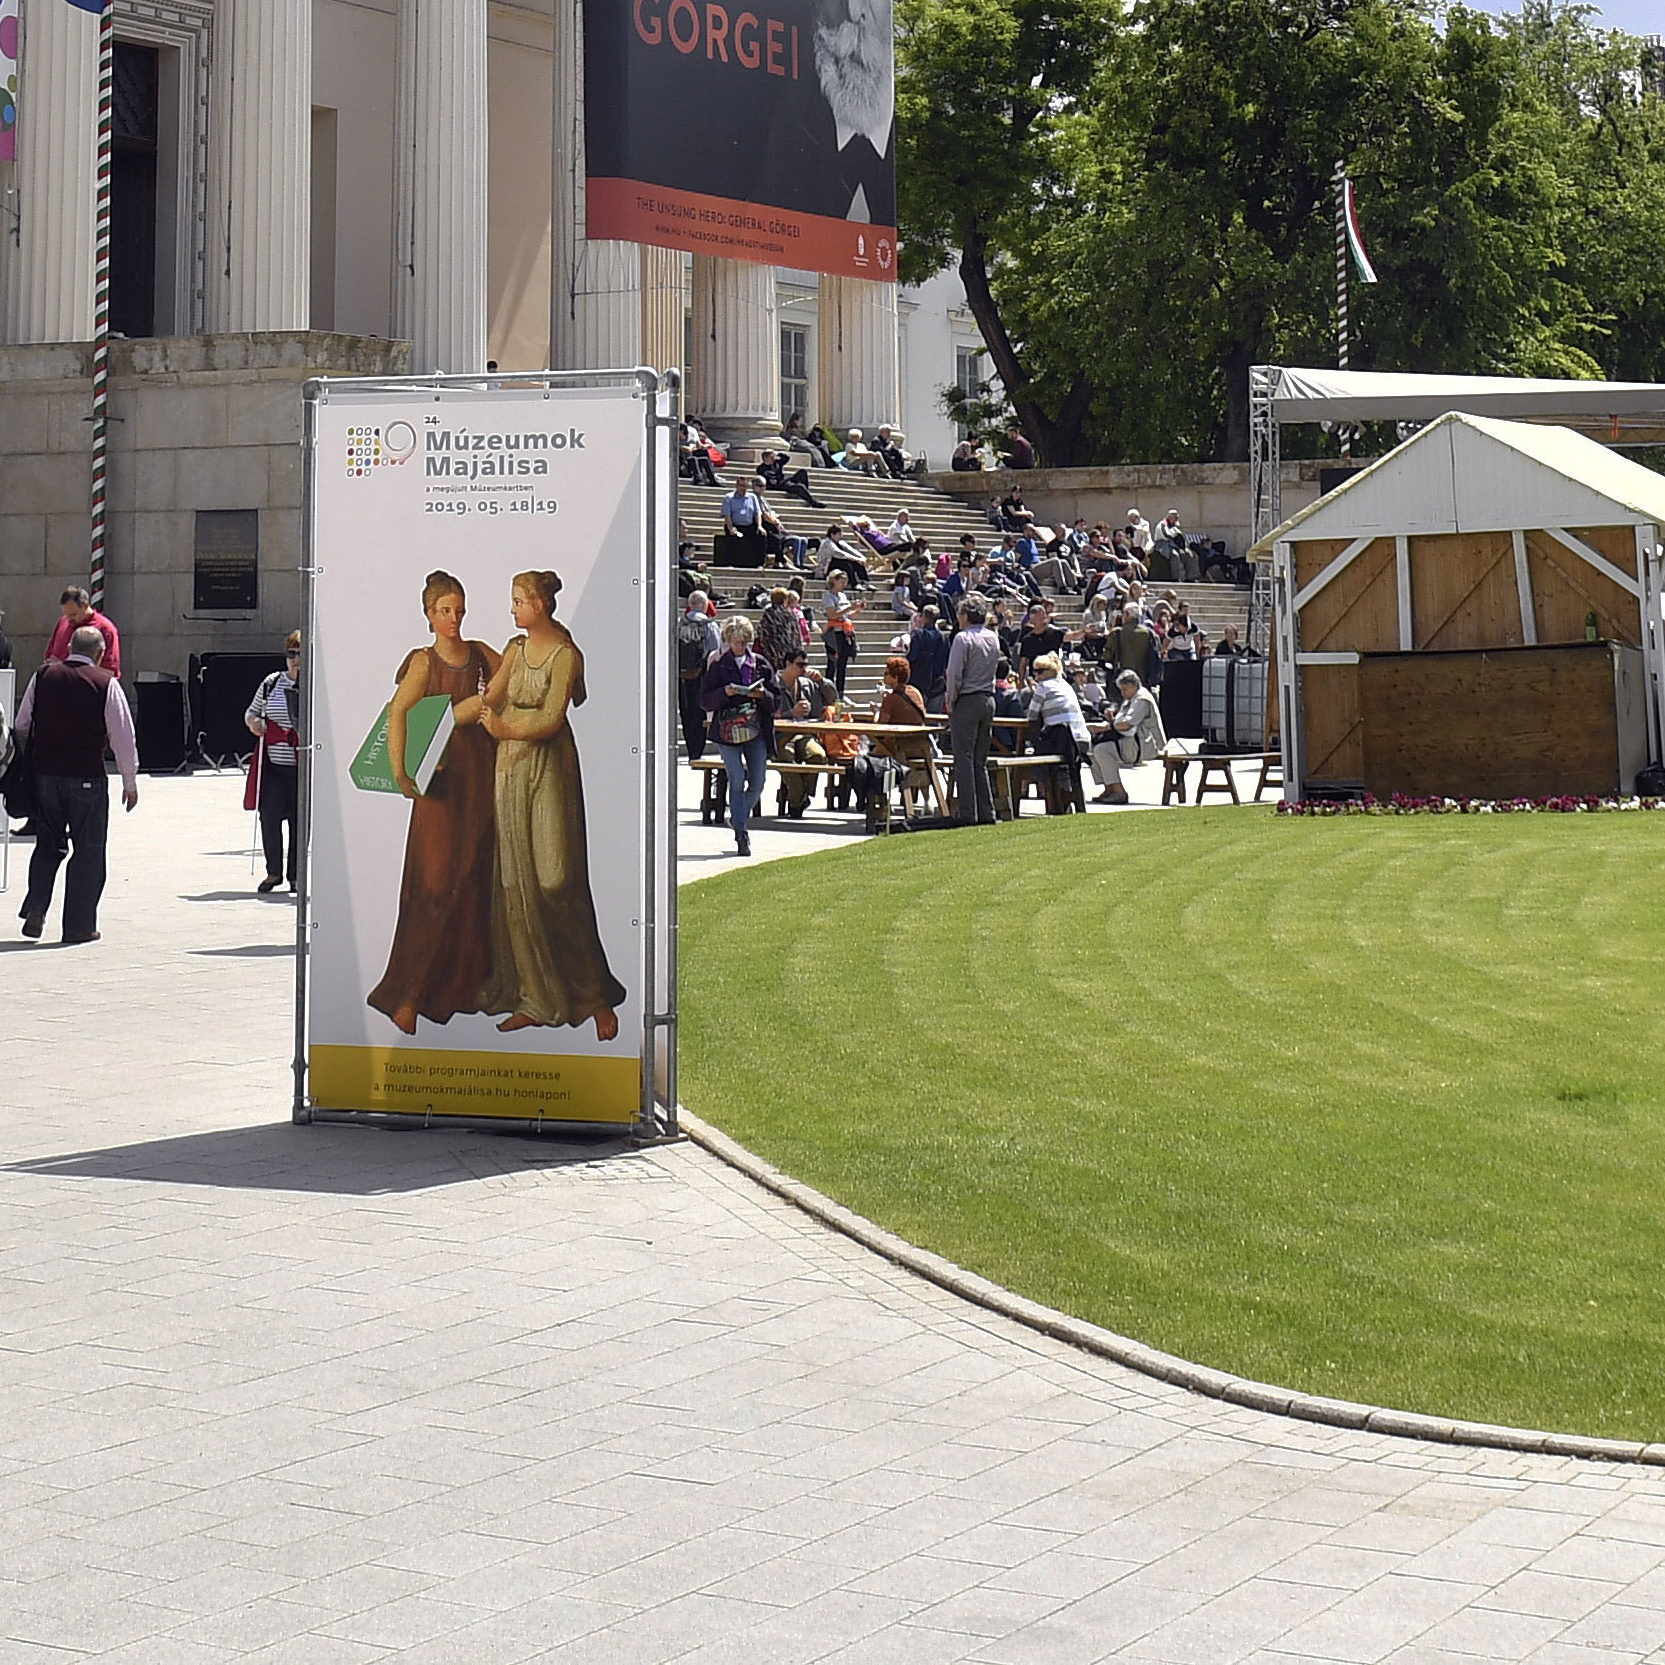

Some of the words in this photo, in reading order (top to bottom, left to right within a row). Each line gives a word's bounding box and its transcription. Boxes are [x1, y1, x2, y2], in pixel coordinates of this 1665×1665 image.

[636, 196, 654, 212] THE
[728, 214, 767, 232] GENERAL
[769, 218, 801, 238] GÖRGEI
[424, 415, 441, 426] 24.
[426, 427, 585, 451] Múzeumok
[426, 452, 548, 481] Majálisa
[425, 500, 472, 515] 2019.
[477, 500, 504, 515] 05.
[383, 1063, 425, 1075] További
[429, 1066, 514, 1078] programjainkat
[518, 1068, 561, 1080] keresse
[514, 1087, 571, 1101] honlapon!
